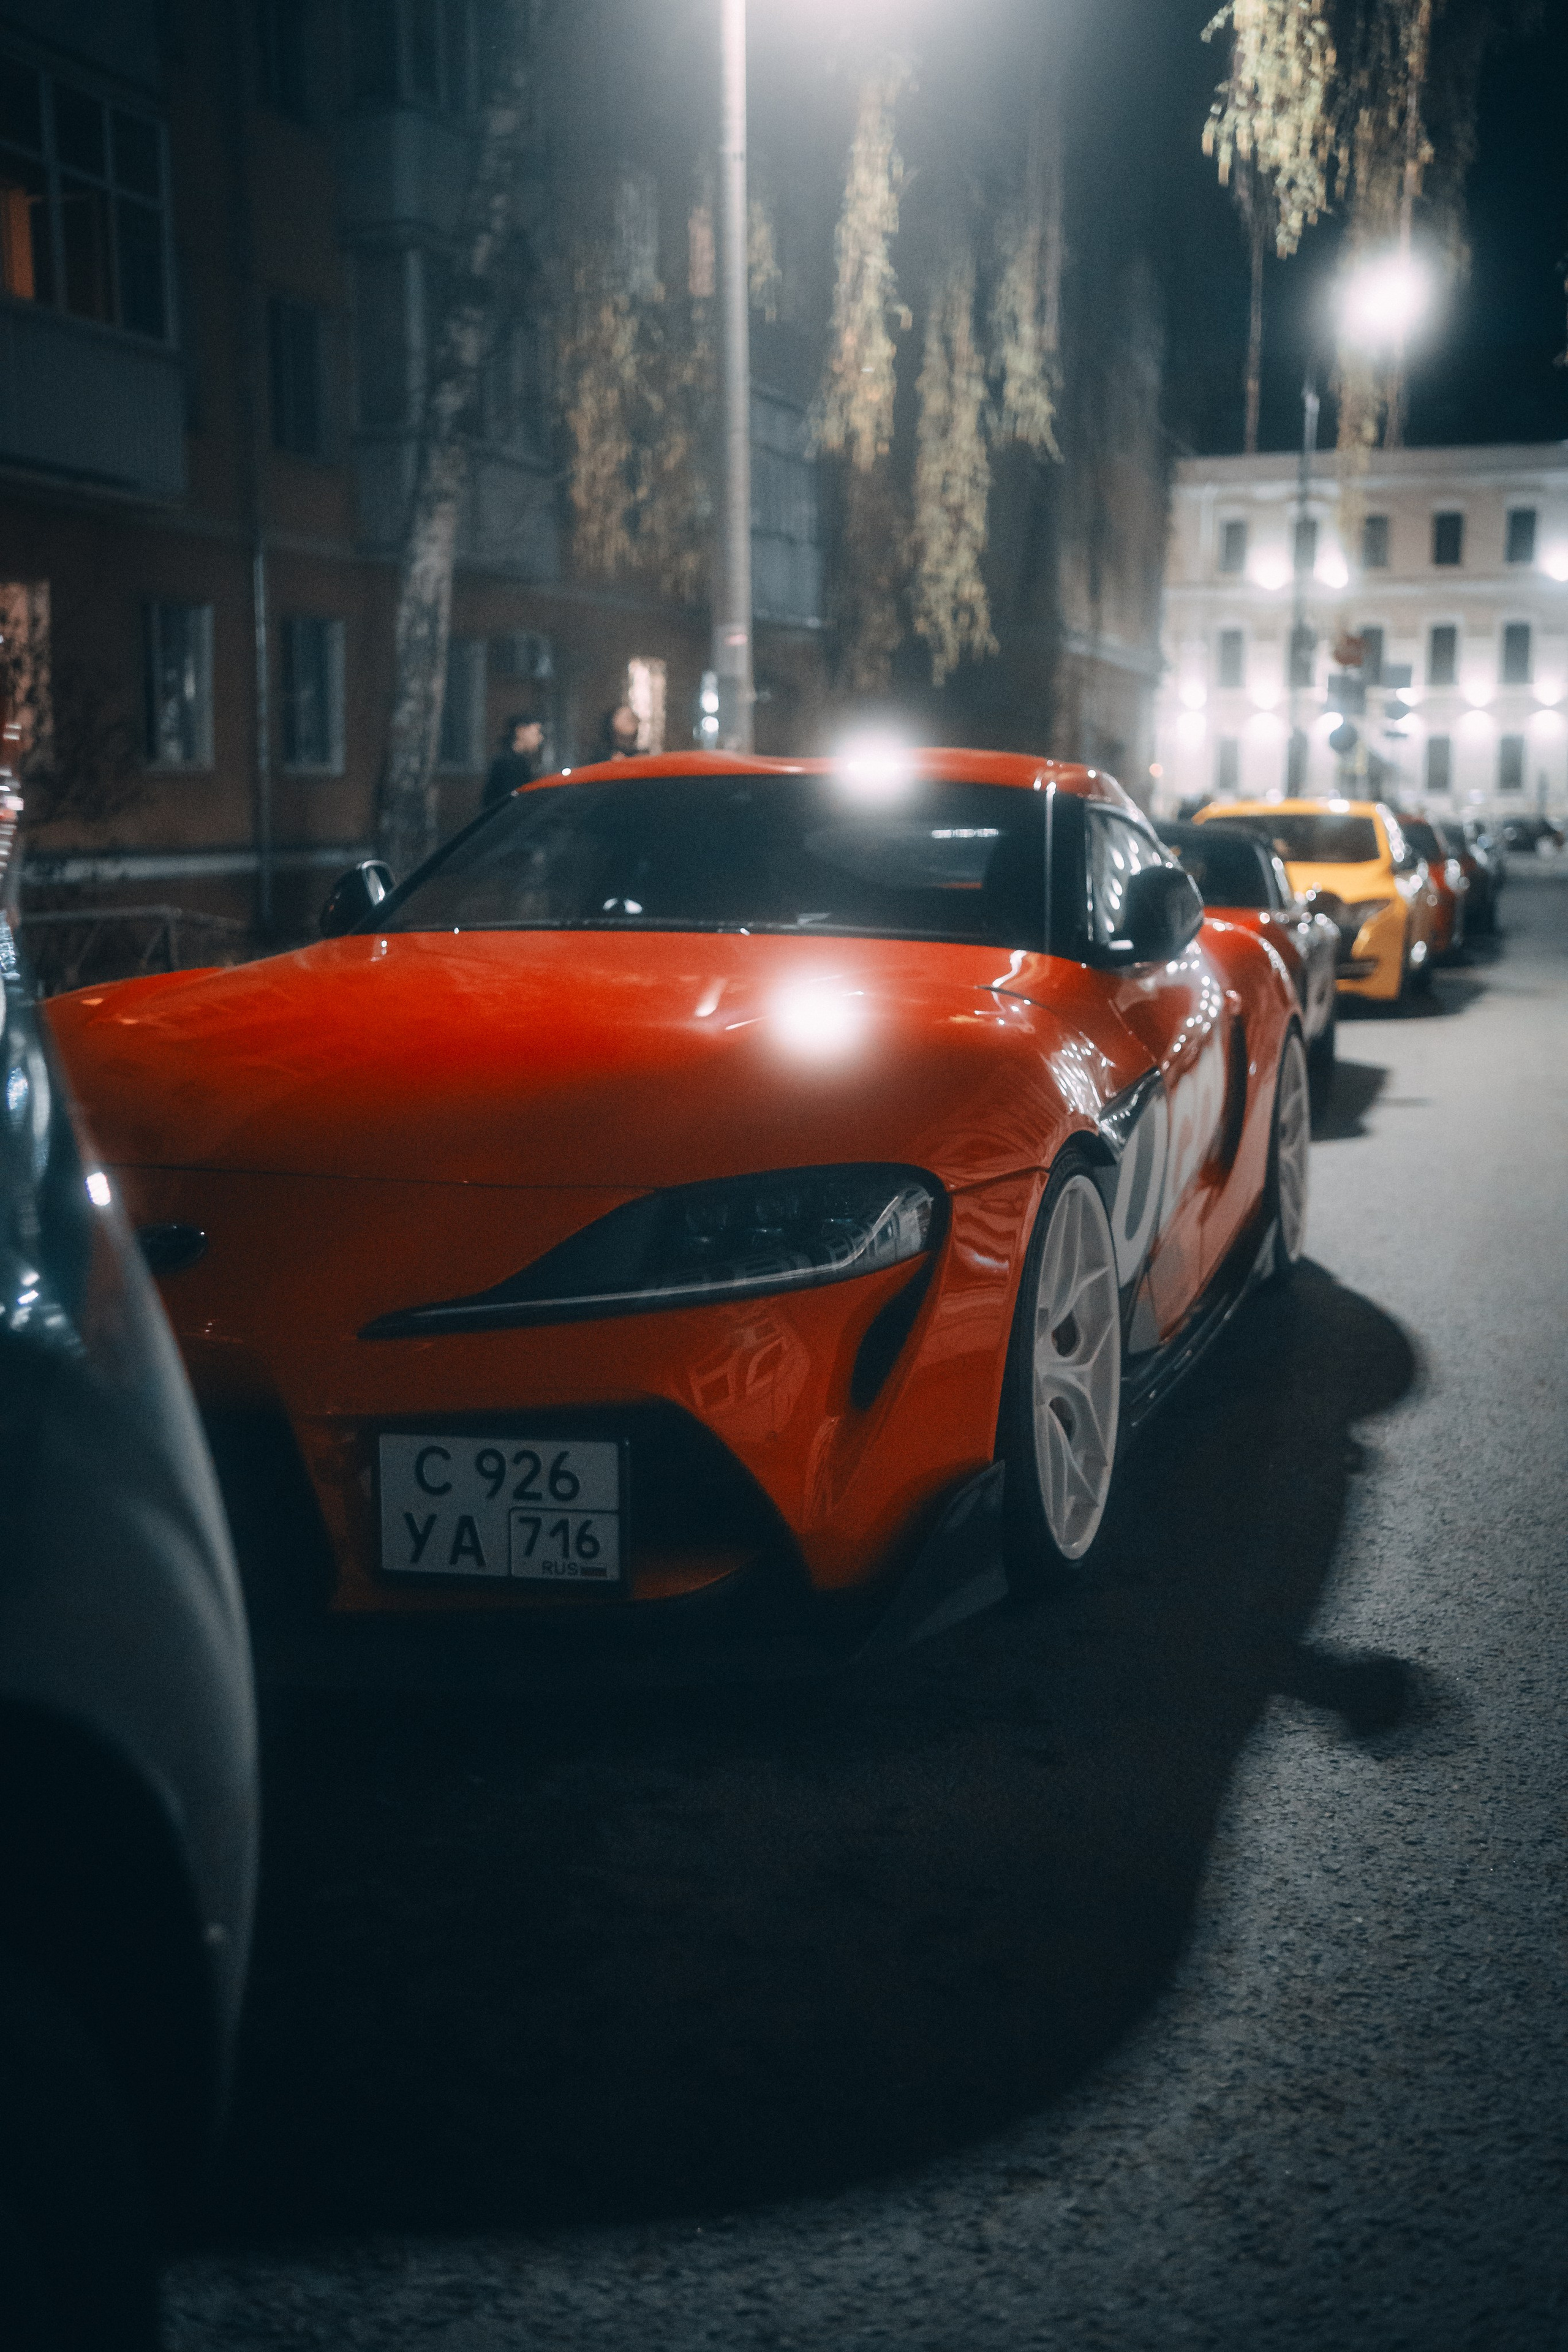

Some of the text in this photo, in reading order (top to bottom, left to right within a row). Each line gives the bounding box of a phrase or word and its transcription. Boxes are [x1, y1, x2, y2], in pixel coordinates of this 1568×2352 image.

[475, 1447, 580, 1502] 926
[518, 1516, 601, 1560] 716
[541, 1560, 578, 1576] RUS
